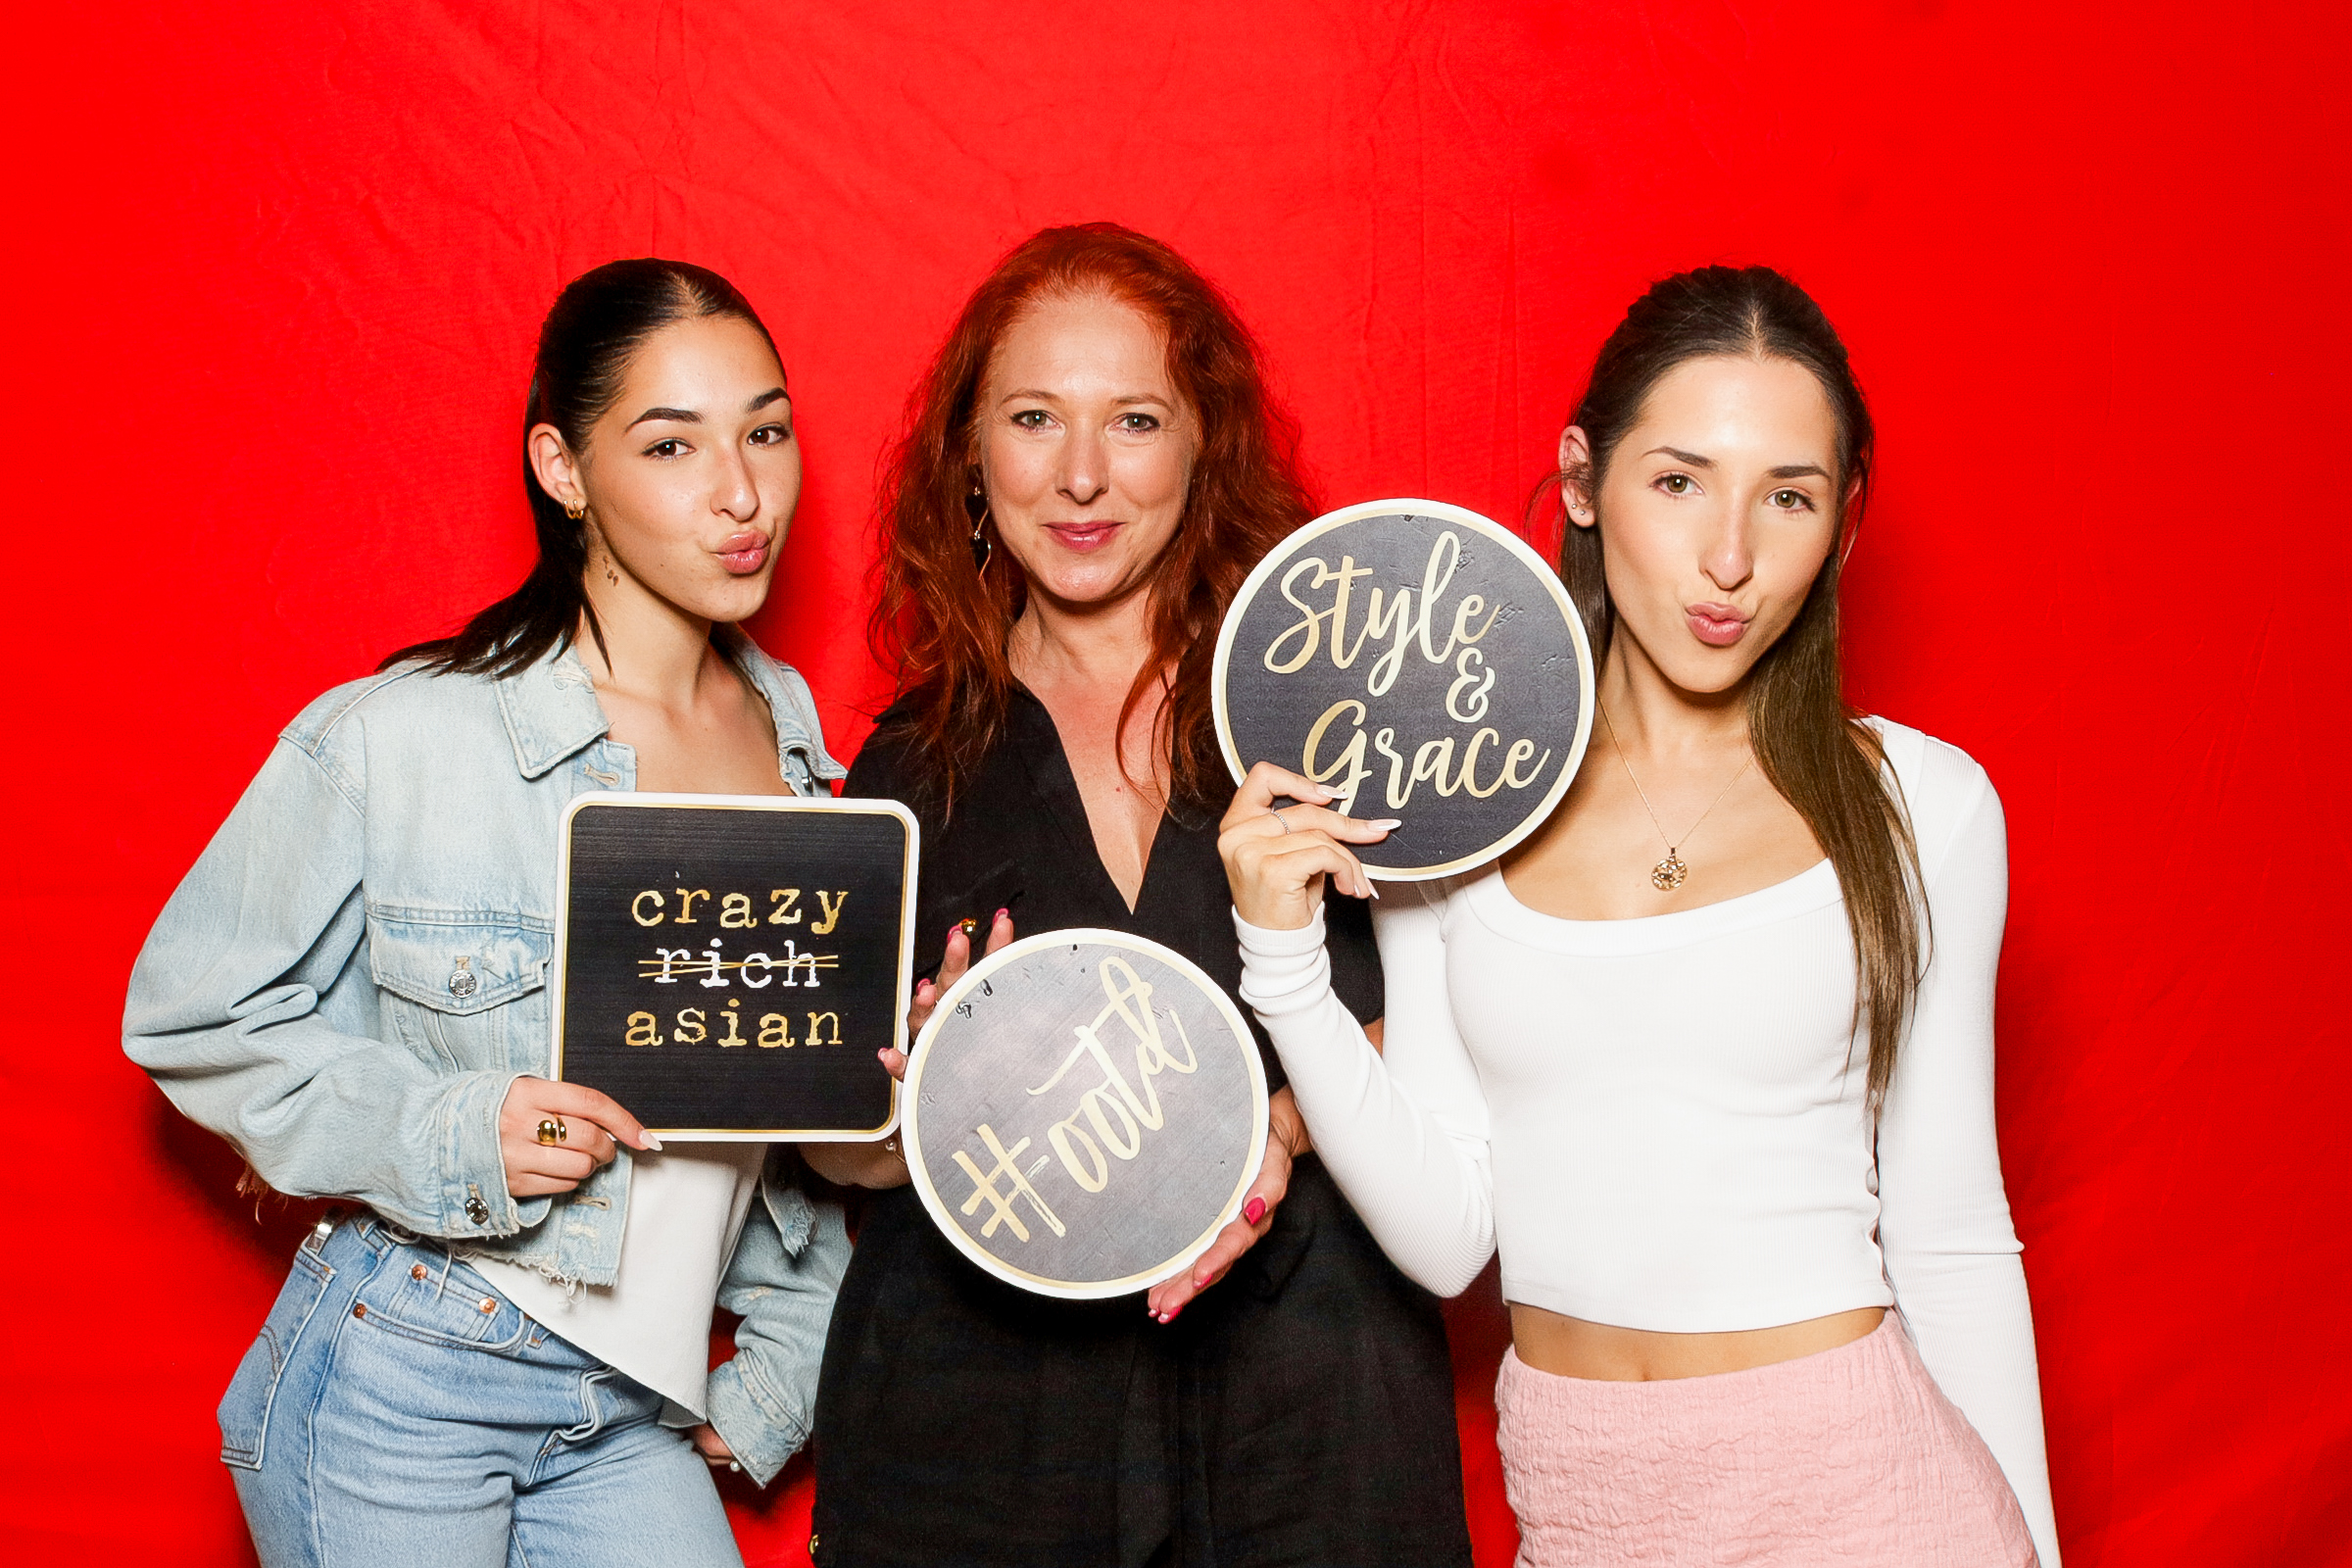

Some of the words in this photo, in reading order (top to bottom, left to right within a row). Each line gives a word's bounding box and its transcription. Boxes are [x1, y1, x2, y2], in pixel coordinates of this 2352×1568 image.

[1263, 530, 1500, 697] Style
[1446, 647, 1495, 723] &
[1302, 699, 1550, 815] Grace
[631, 887, 849, 935] crazy
[653, 938, 820, 989] rich
[624, 998, 844, 1049] asian
[951, 956, 1198, 1243] #ootd
